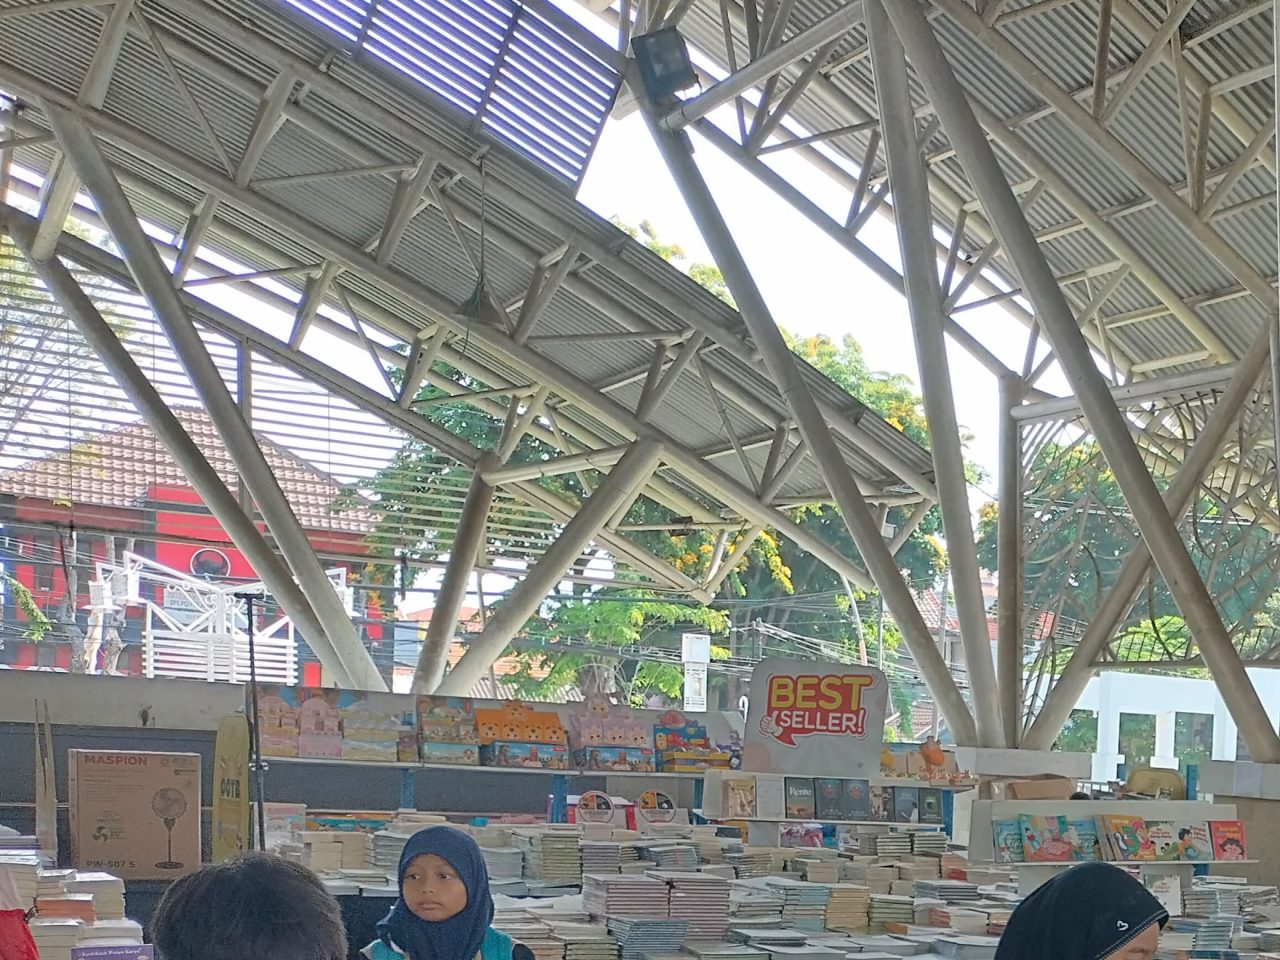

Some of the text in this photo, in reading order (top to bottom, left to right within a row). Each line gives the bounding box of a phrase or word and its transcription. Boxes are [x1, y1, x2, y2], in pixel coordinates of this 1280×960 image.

[770, 676, 873, 711] BEST
[779, 709, 864, 733] SELLER!
[84, 755, 148, 766] MASPION
